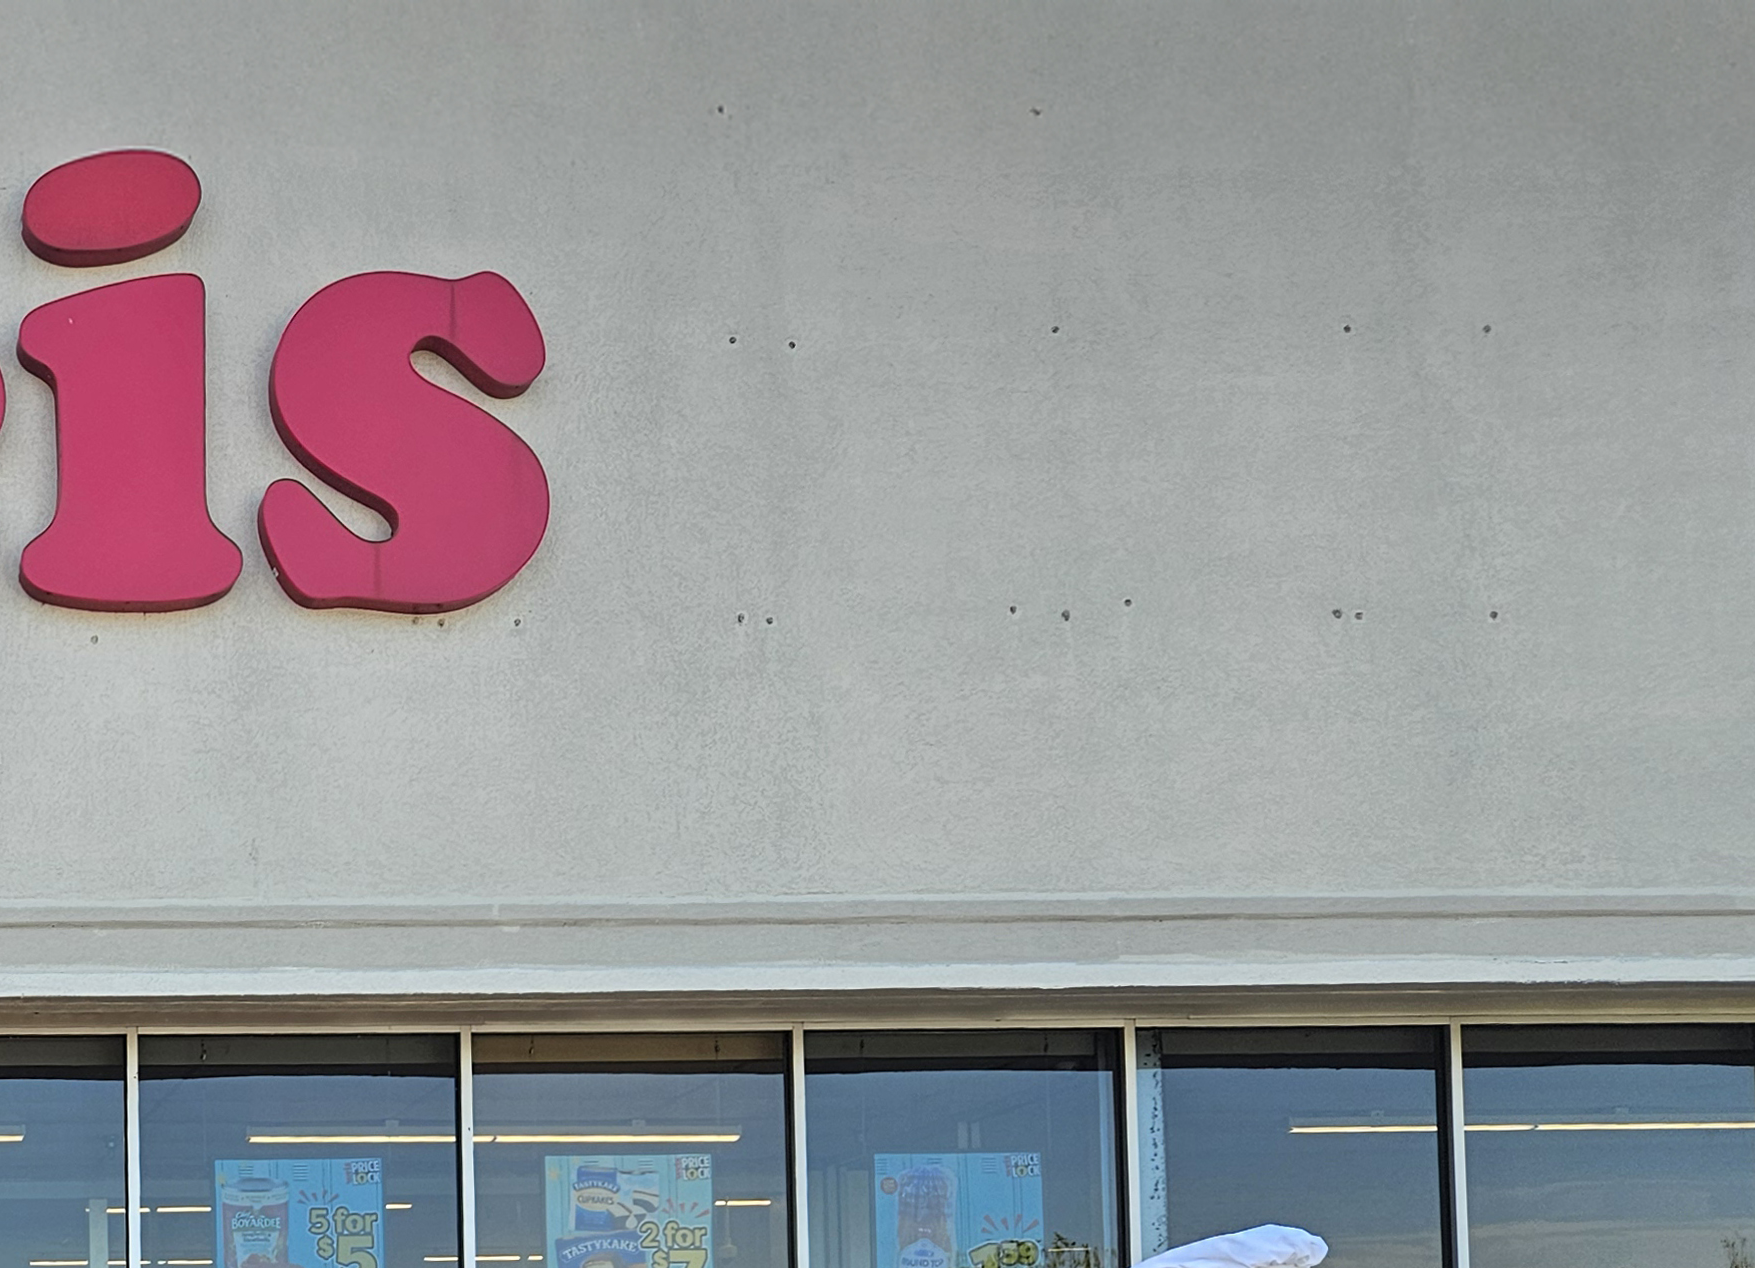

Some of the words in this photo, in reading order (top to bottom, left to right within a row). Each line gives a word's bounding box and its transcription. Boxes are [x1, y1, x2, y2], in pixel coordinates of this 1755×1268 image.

[351, 1160, 379, 1172] PRICE
[681, 1156, 710, 1168] PRICE
[1011, 1154, 1039, 1165] PRICE
[231, 1216, 281, 1230] BOYARDEE
[308, 1207, 330, 1234] 5
[333, 1206, 378, 1234] for
[639, 1220, 660, 1249] 2
[664, 1220, 707, 1249] for
[562, 1237, 640, 1259] TASTYKAKE
